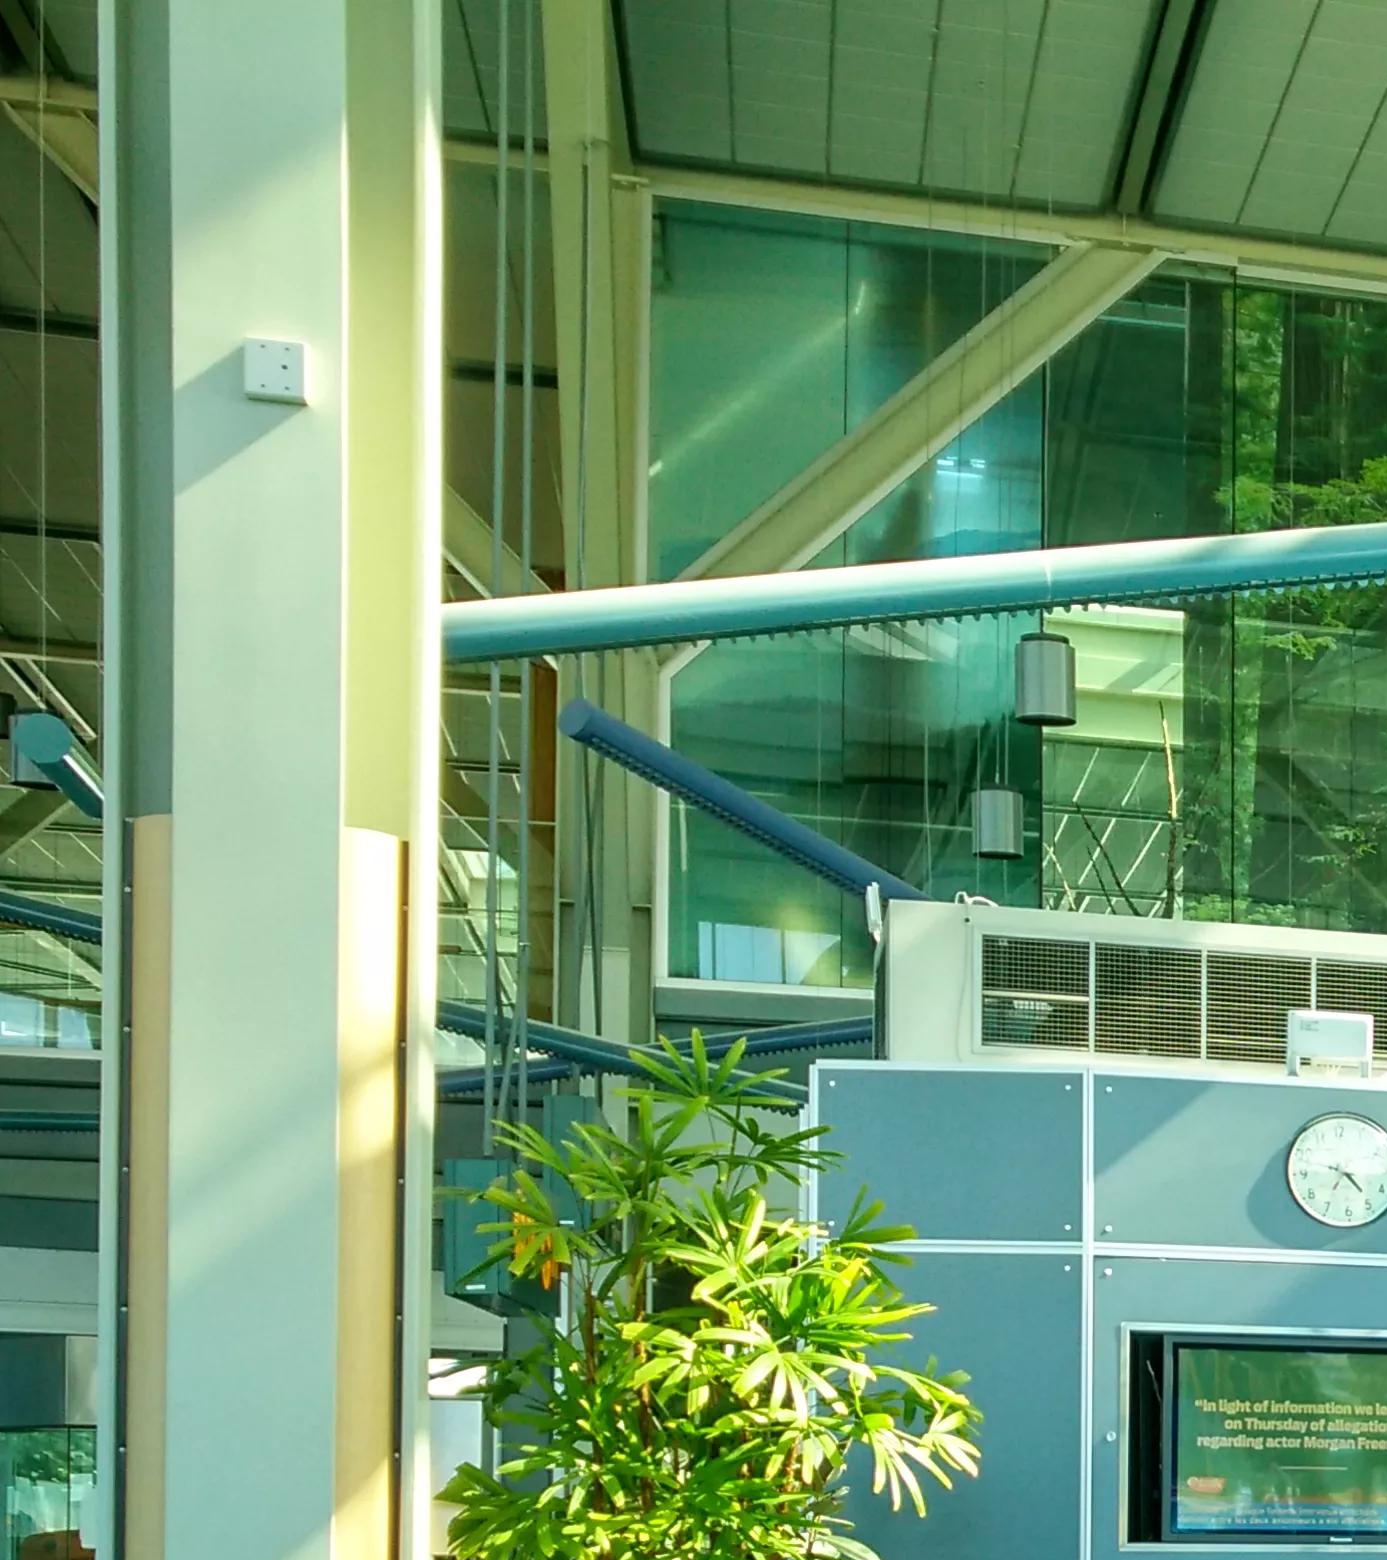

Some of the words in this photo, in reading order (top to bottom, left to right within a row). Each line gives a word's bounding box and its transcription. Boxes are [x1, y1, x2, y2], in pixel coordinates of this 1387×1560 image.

[1334, 1126, 1344, 1138] 12
[1345, 1206, 1353, 1217] 6
[1364, 1199, 1372, 1211] 5
[1219, 1399, 1251, 1415] light
[1253, 1400, 1270, 1413] of
[1271, 1400, 1353, 1416] information
[1354, 1404, 1374, 1416] we
[1224, 1419, 1243, 1430] on
[1244, 1417, 1309, 1434] Thursday
[1309, 1419, 1326, 1431] of
[1196, 1434, 1265, 1450] regarding
[1265, 1437, 1302, 1448] actor
[1303, 1436, 1356, 1451] Morgan
